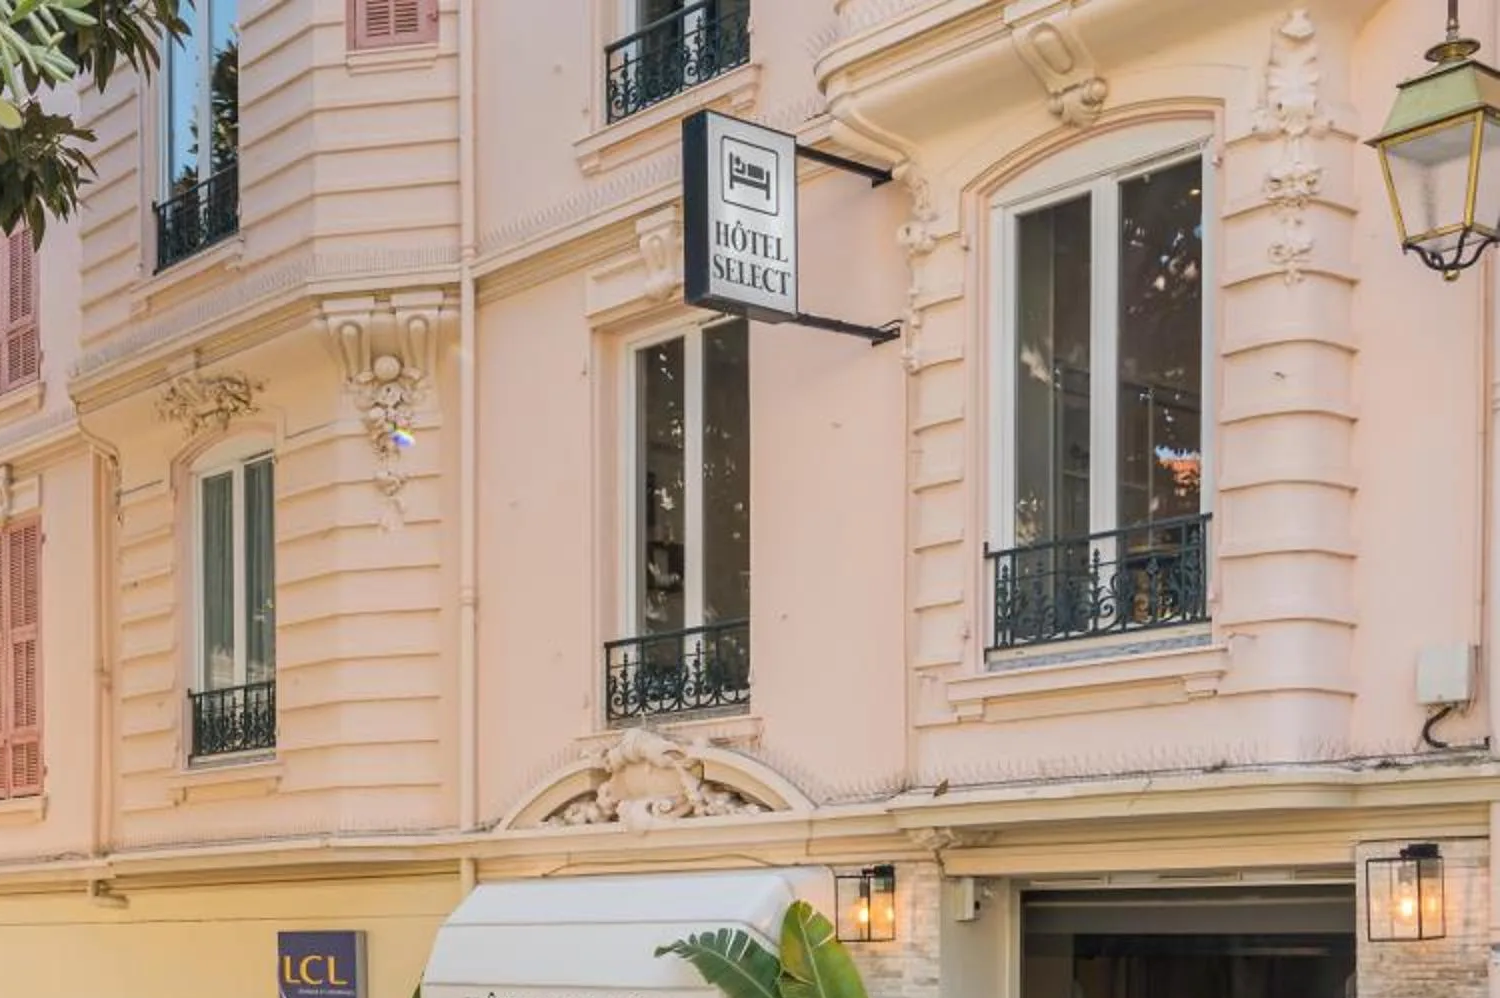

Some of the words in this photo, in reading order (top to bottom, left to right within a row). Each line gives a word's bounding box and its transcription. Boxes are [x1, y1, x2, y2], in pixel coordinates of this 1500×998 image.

[716, 220, 789, 263] HÔTEL
[712, 253, 792, 296] SELECT
[283, 955, 349, 985] LCL
